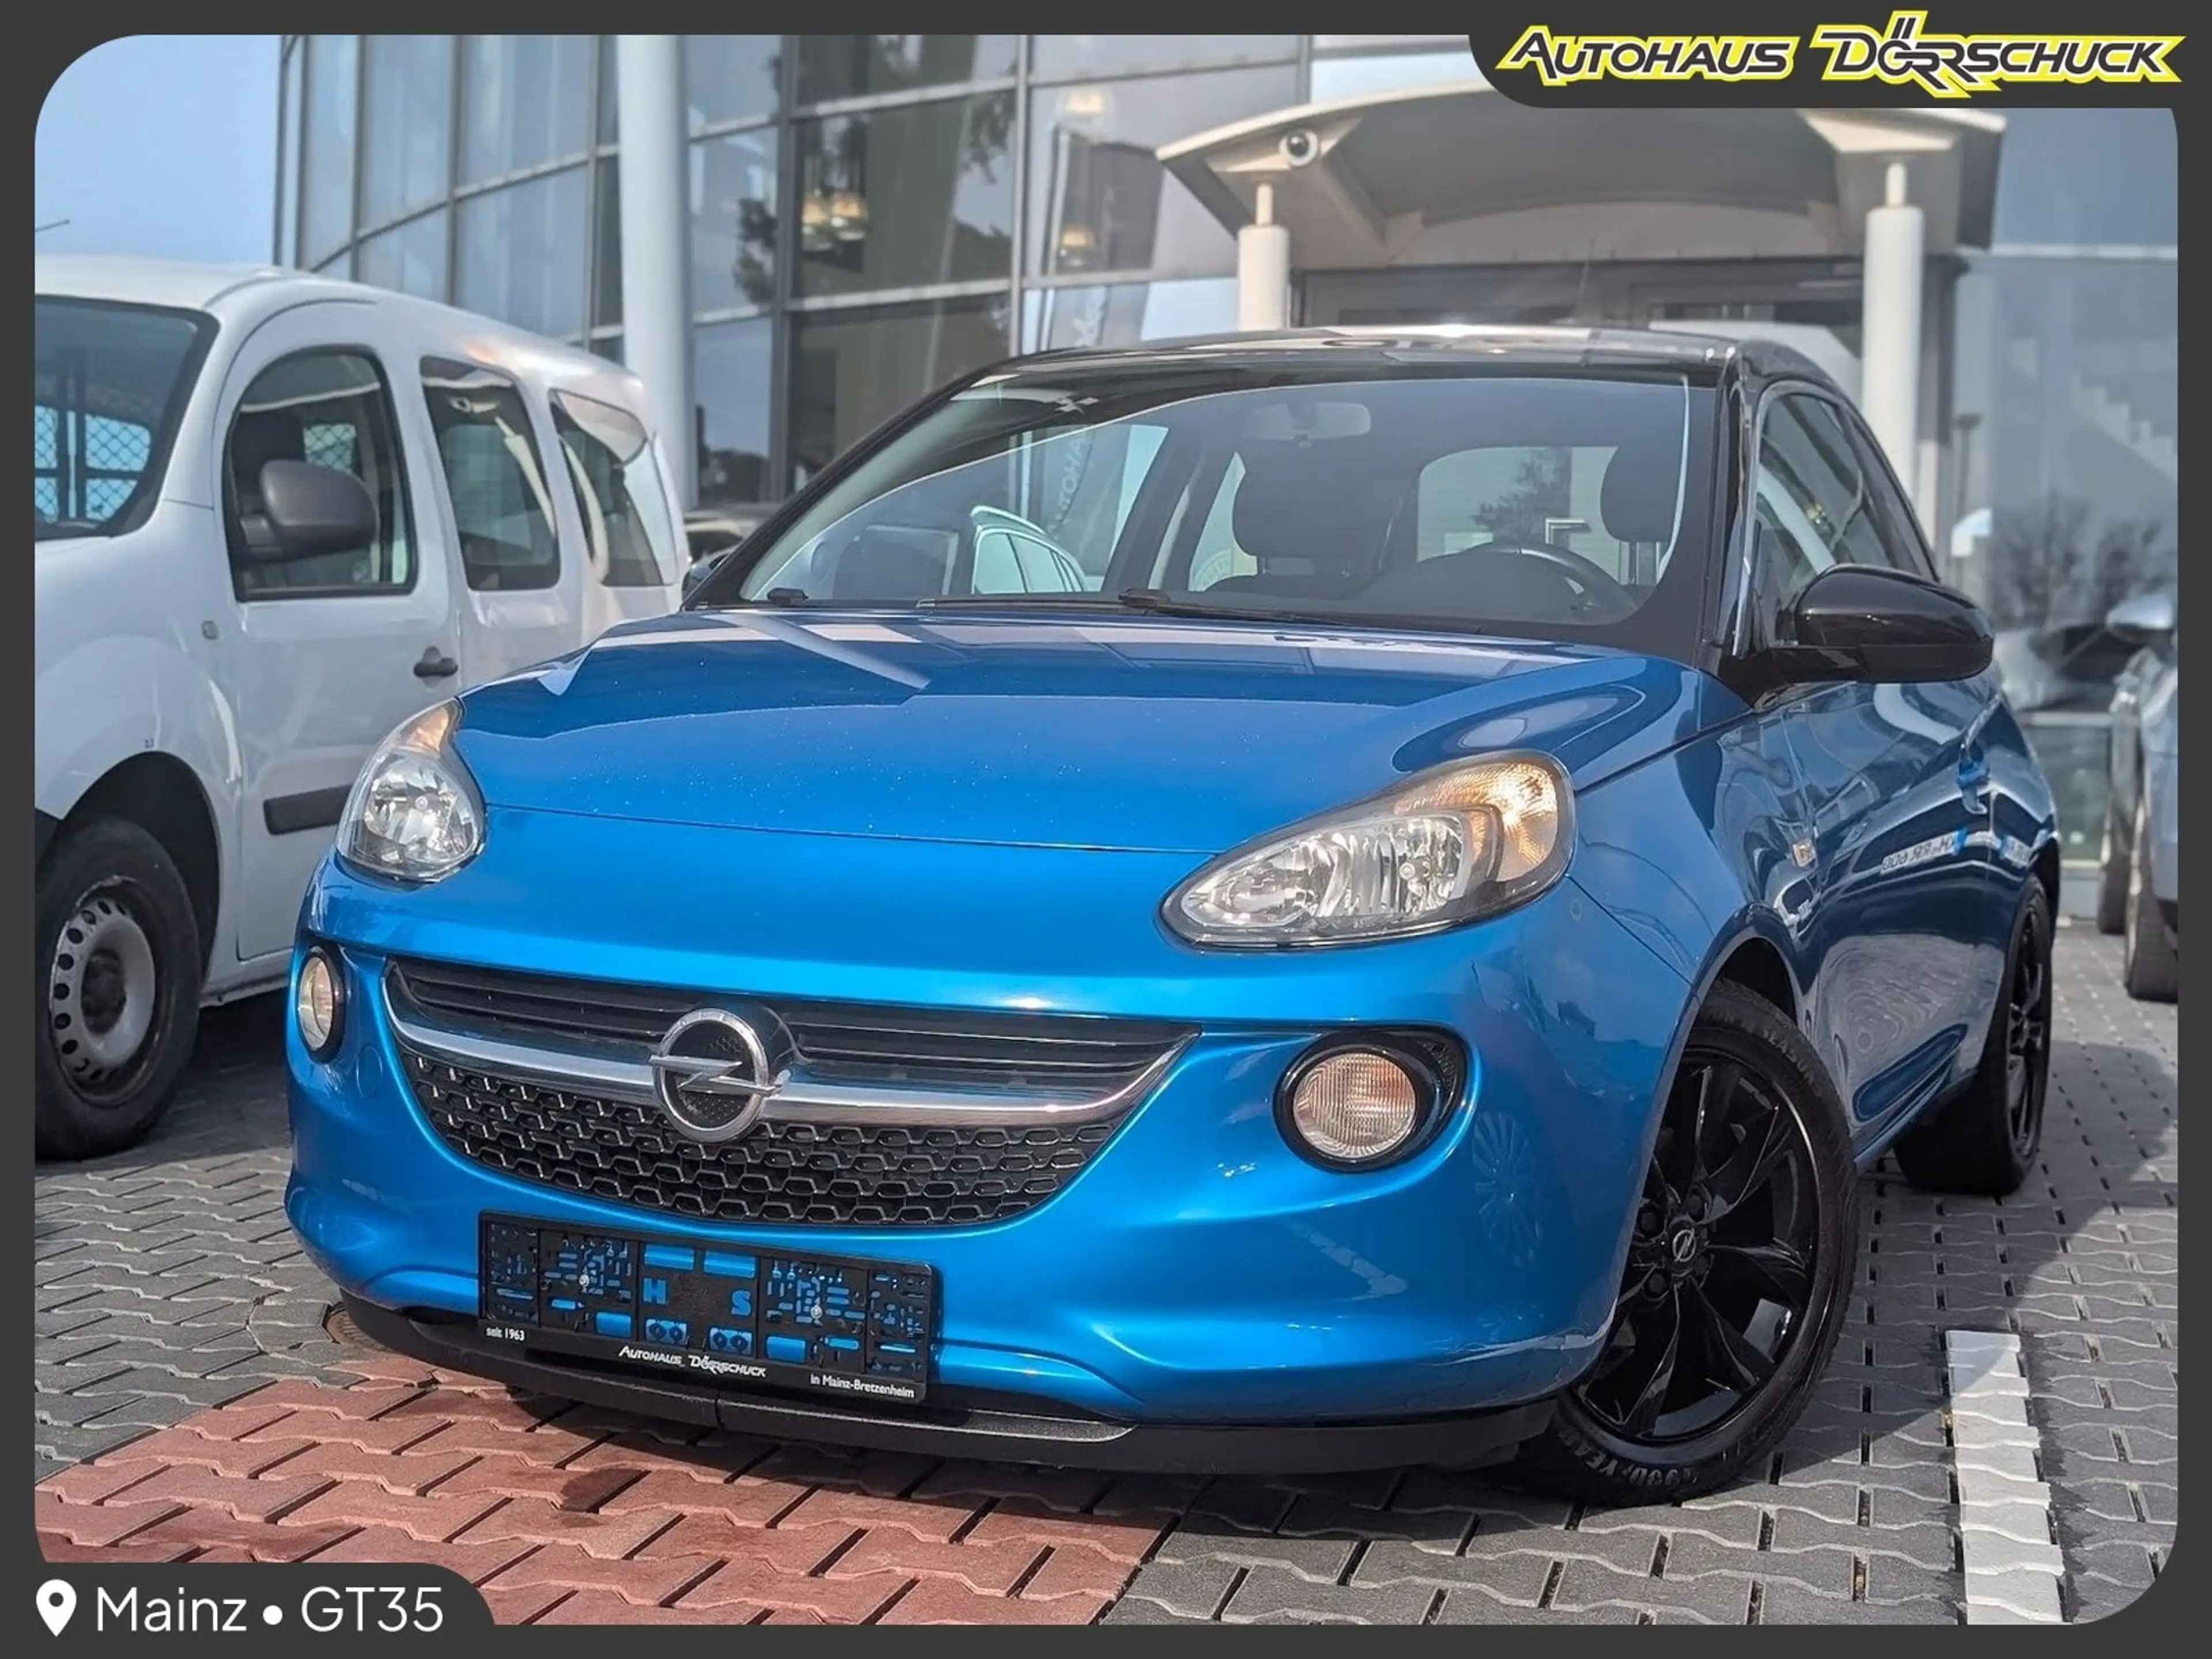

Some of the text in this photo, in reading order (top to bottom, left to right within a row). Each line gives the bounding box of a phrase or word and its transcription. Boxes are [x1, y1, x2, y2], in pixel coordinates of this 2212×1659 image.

[505, 1328, 525, 1341] 1963
[619, 1346, 683, 1367] AUTOHAUS
[822, 1375, 915, 1399] Mainz-Bretzenheim
